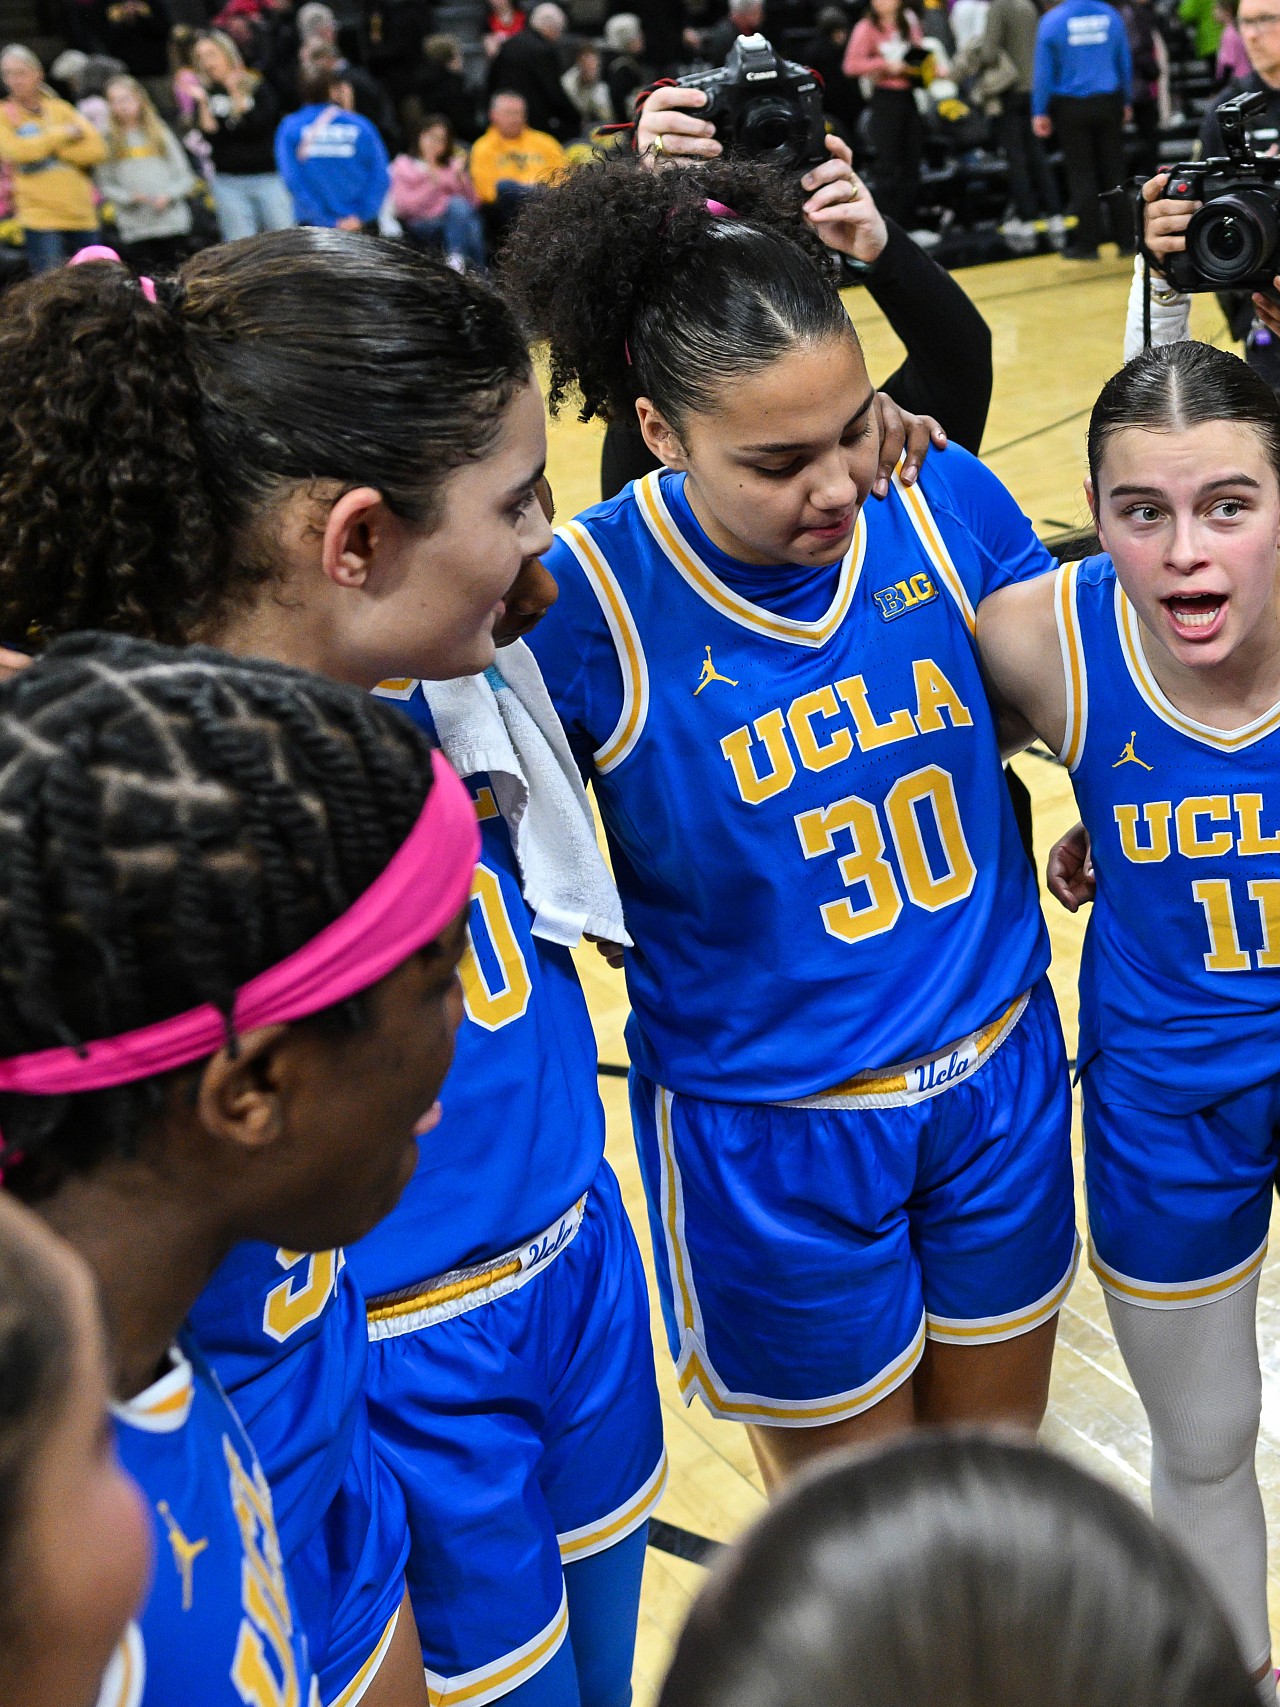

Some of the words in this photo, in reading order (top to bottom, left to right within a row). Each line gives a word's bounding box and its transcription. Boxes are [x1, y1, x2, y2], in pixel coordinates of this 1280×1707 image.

[719, 658, 975, 806] UCLA
[793, 763, 978, 944] 30
[914, 1051, 970, 1092] Ucla
